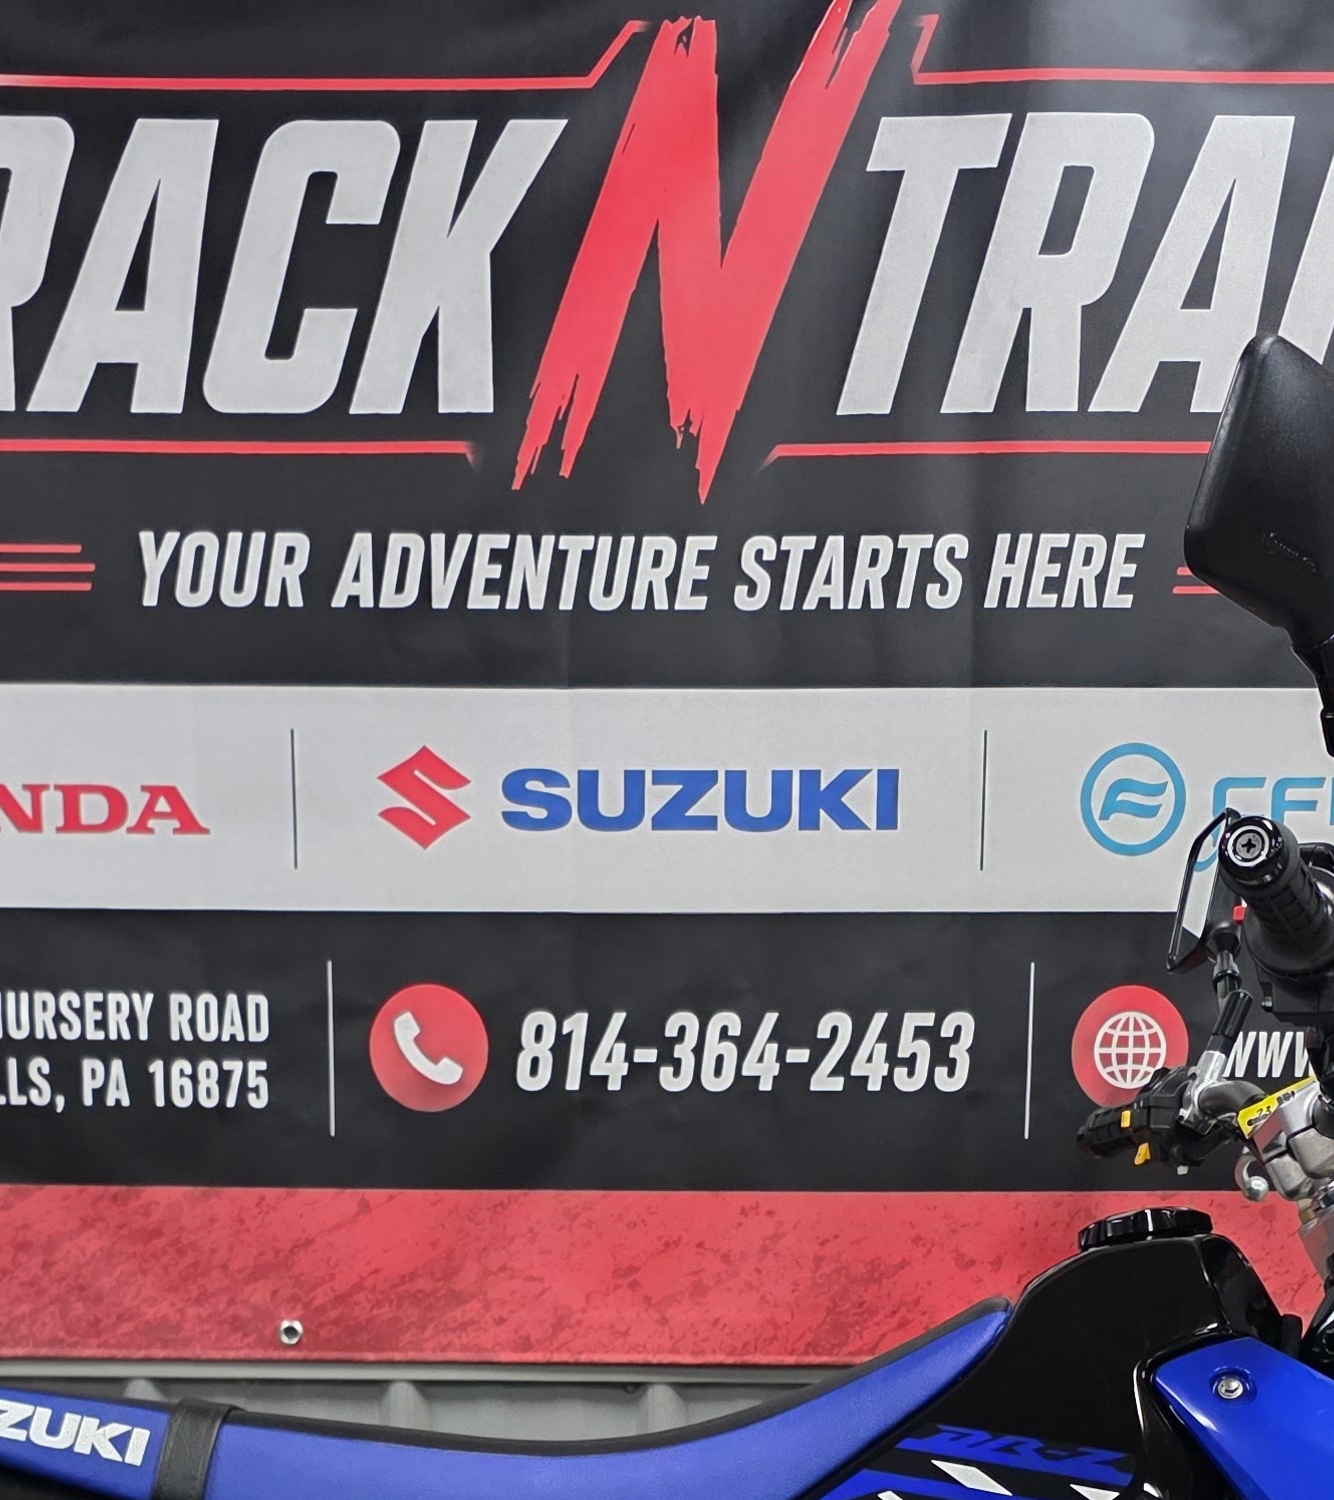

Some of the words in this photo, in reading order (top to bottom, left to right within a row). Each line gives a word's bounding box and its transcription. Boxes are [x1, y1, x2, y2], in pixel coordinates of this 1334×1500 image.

[511, 0, 901, 504] N
[139, 531, 313, 608] YOUR
[330, 531, 719, 611] ADVENTURE
[733, 533, 969, 611] STARTS
[984, 533, 1145, 610] HERE
[501, 768, 900, 832] SUZUKI
[169, 993, 270, 1043] ROAD
[515, 1010, 976, 1093] 814-364-2453
[81, 1058, 131, 1108] PA
[147, 1059, 270, 1110] 16875
